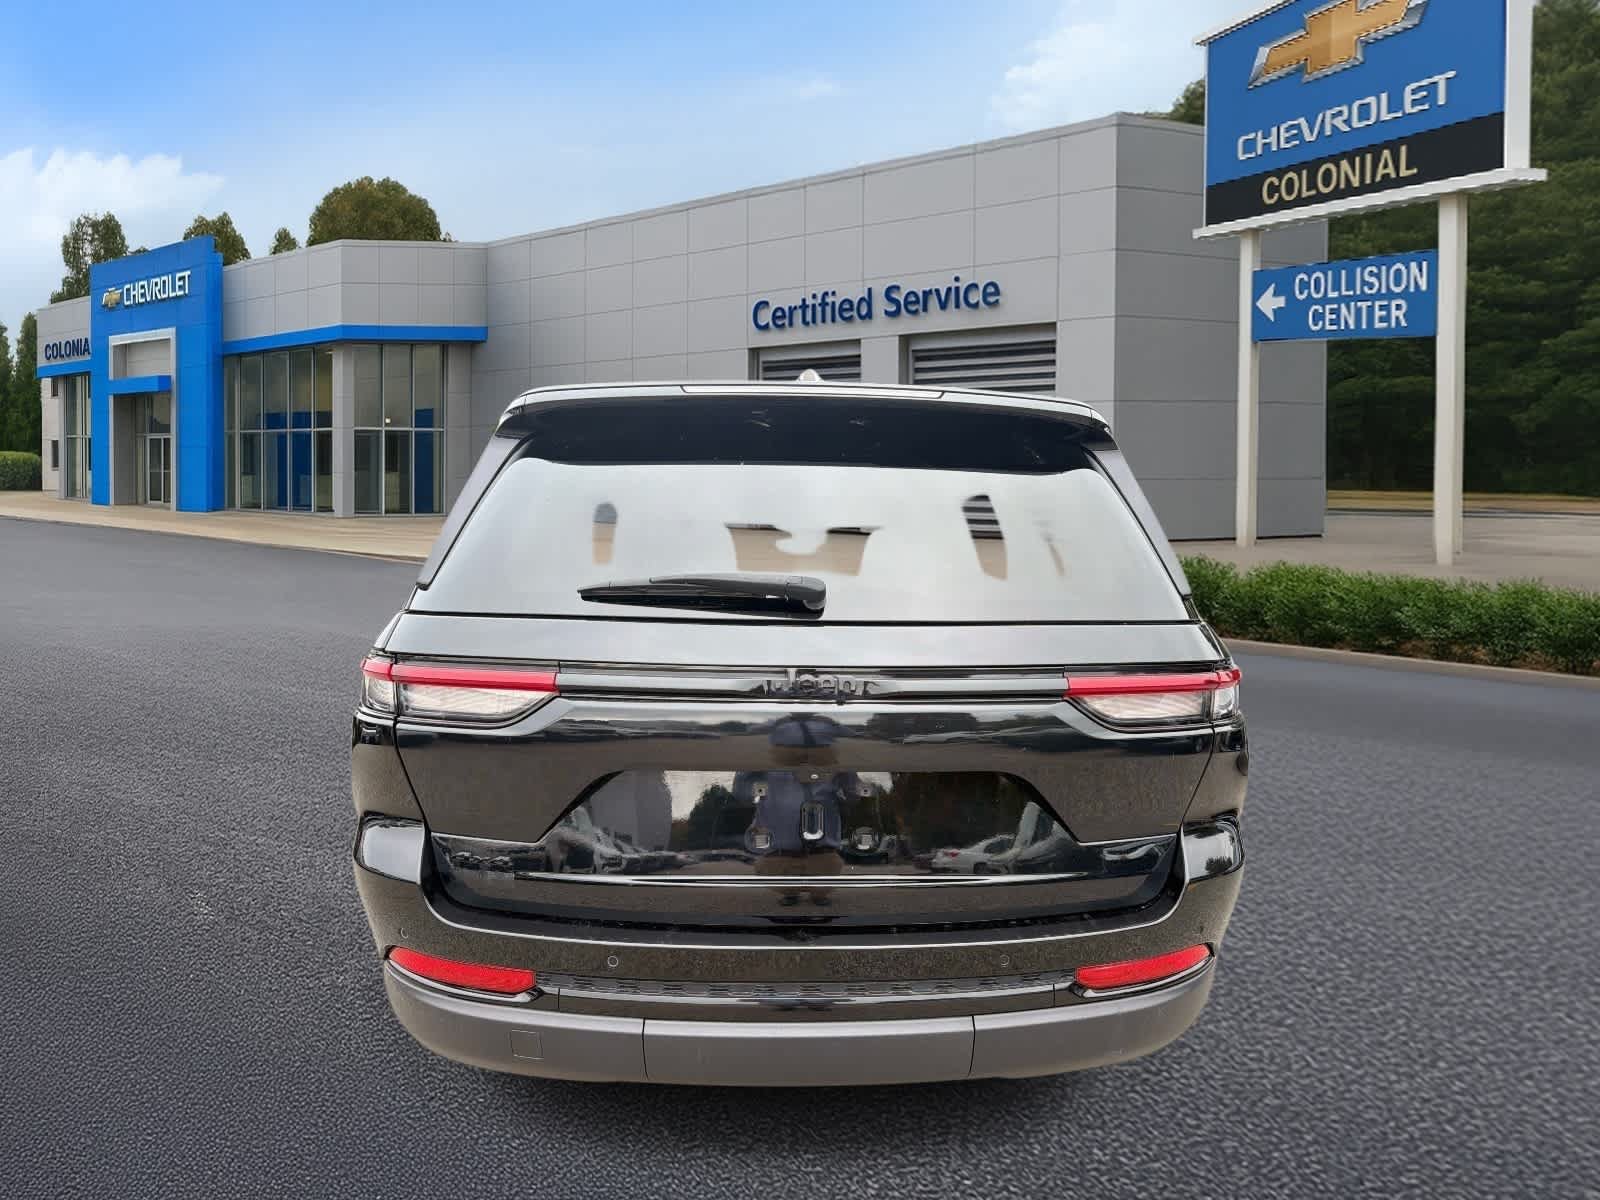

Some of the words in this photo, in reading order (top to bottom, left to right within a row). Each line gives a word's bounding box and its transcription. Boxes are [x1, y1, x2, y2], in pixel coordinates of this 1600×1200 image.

[1237, 70, 1457, 160] CHEVROLET
[1261, 145, 1418, 205] COLONIAL
[123, 270, 191, 306] CHEVROLET
[752, 287, 873, 331] Certified
[883, 275, 1001, 318] Service
[1294, 260, 1428, 301] COLLISION
[1308, 299, 1408, 331] CENTER
